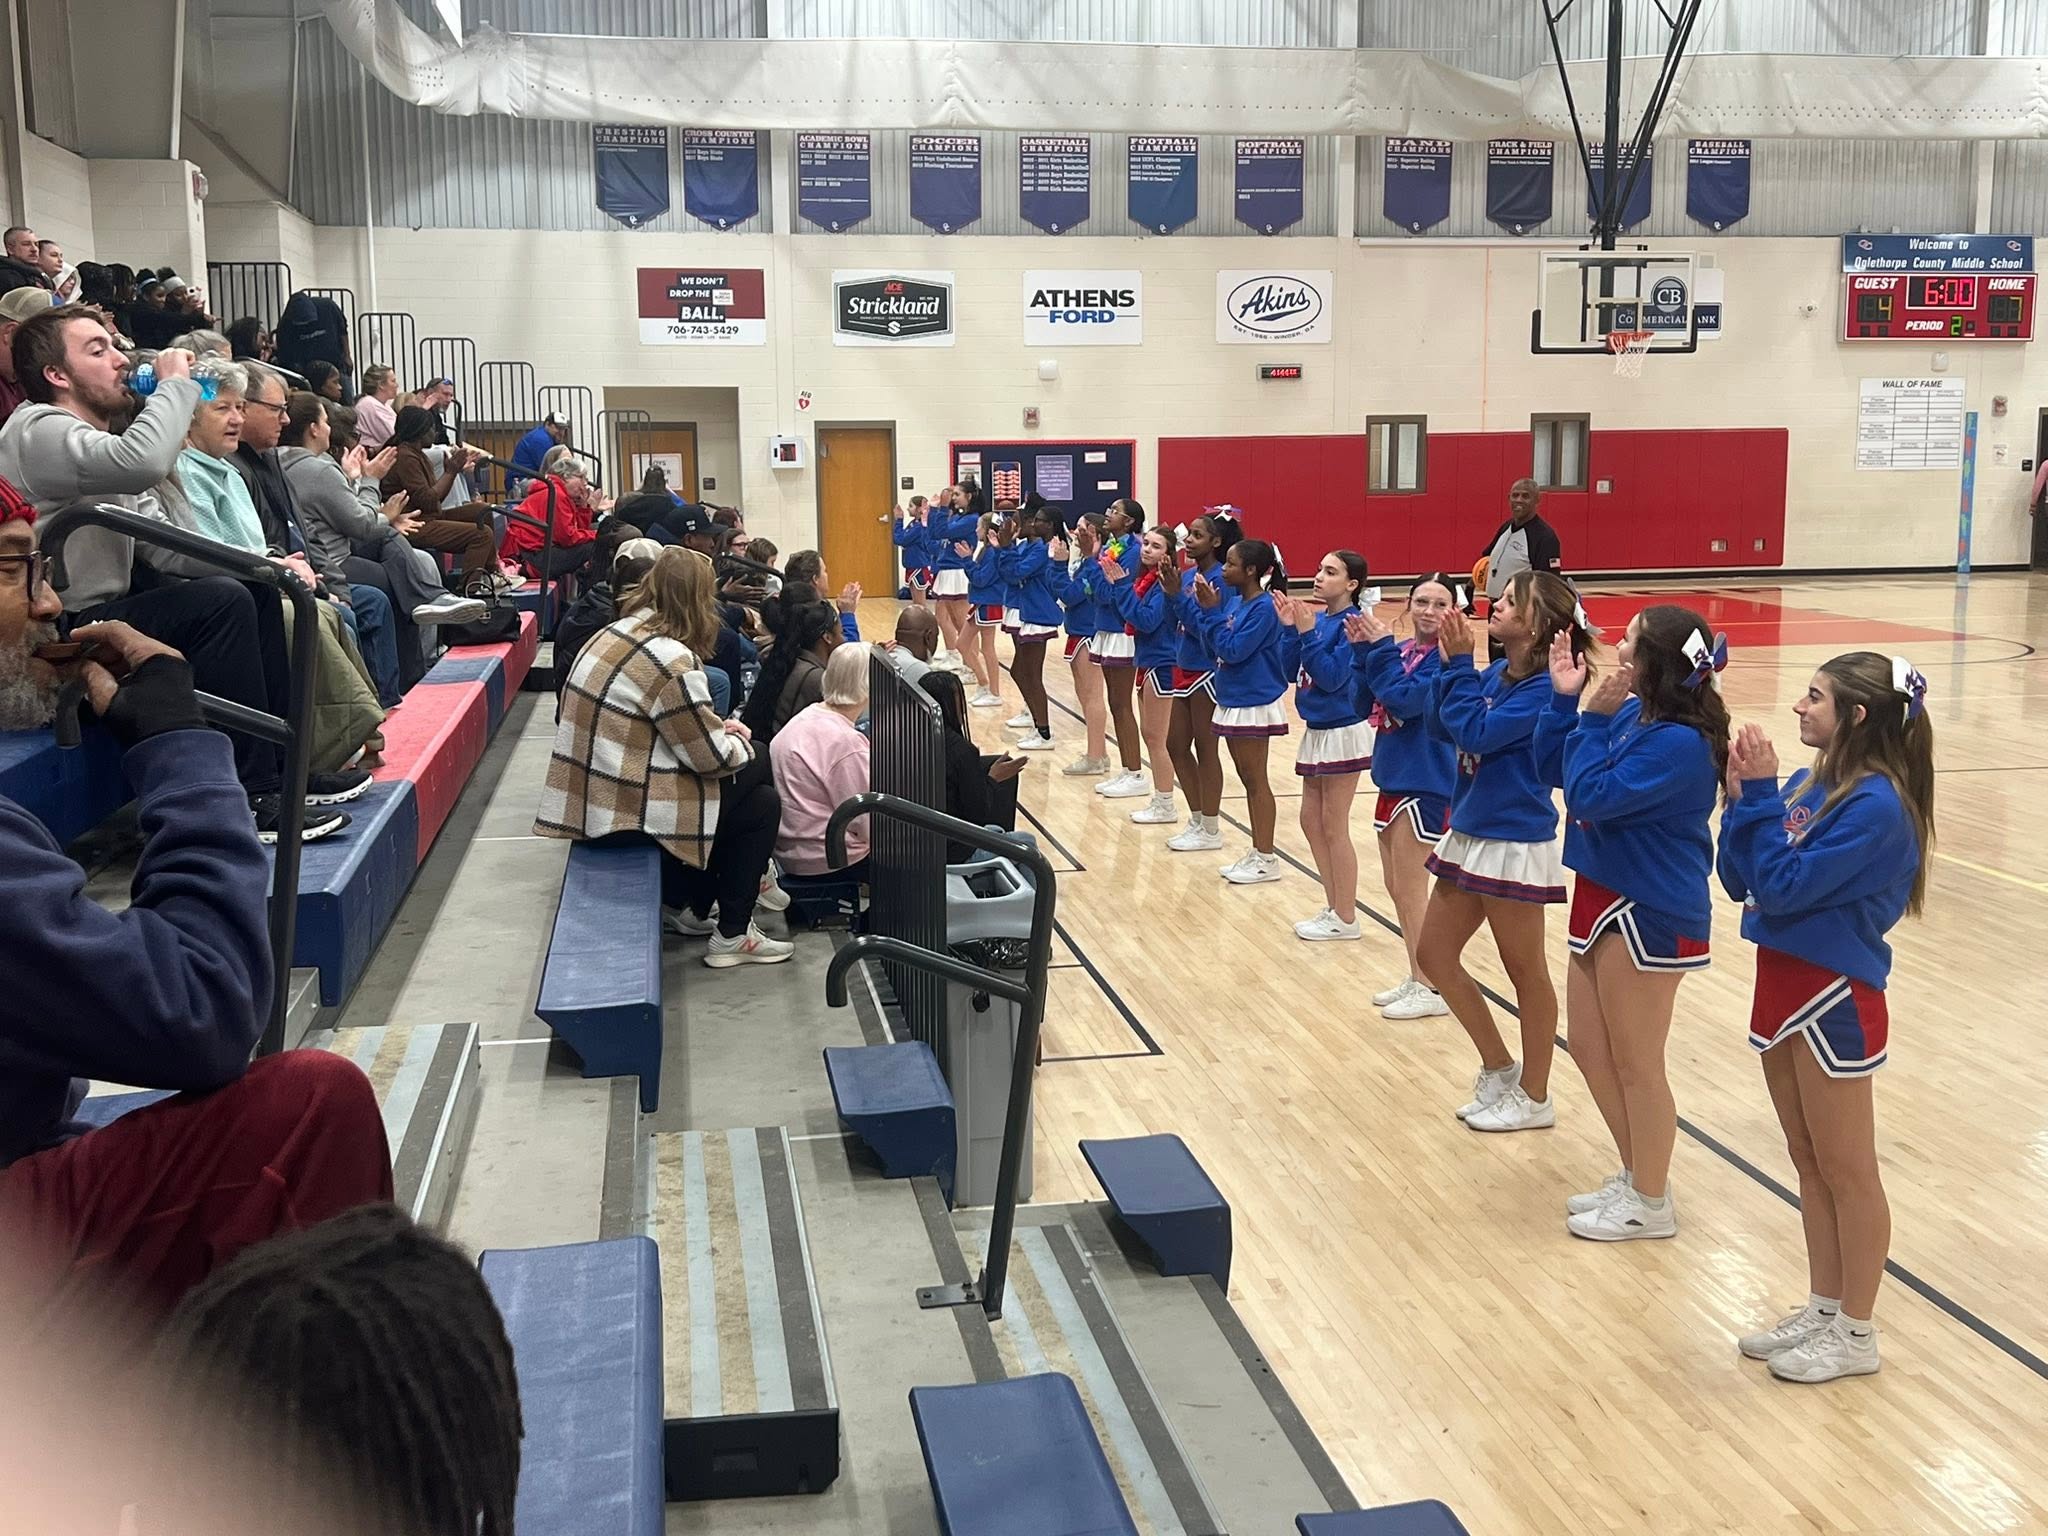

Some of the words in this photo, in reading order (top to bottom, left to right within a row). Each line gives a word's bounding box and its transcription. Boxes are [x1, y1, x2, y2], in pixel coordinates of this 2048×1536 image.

[595, 128, 665, 136] WRESTLING
[596, 136, 666, 144] CHAMPIONS
[1909, 238, 1953, 250] Welcome
[1959, 239, 1969, 250] to
[1854, 256, 1907, 270] Oglethorpe
[1913, 257, 1946, 270] County
[1952, 258, 1984, 269] Middle
[1990, 258, 2023, 269] School
[885, 282, 904, 292] ACE
[1854, 278, 1898, 289] GUEST
[1988, 279, 2027, 290] HOME
[1658, 289, 1681, 304] CB
[1925, 279, 1973, 305] 6:00
[848, 296, 940, 315] Strickland
[1030, 290, 1135, 308] ATHENS
[1239, 285, 1309, 318] Akins
[681, 307, 724, 320] BALL.
[1878, 296, 1892, 320] 4
[1050, 310, 1115, 323] FORD
[667, 326, 739, 334] 706-743-5429
[1905, 321, 1944, 330] PERIOD
[1951, 316, 1963, 336] 2
